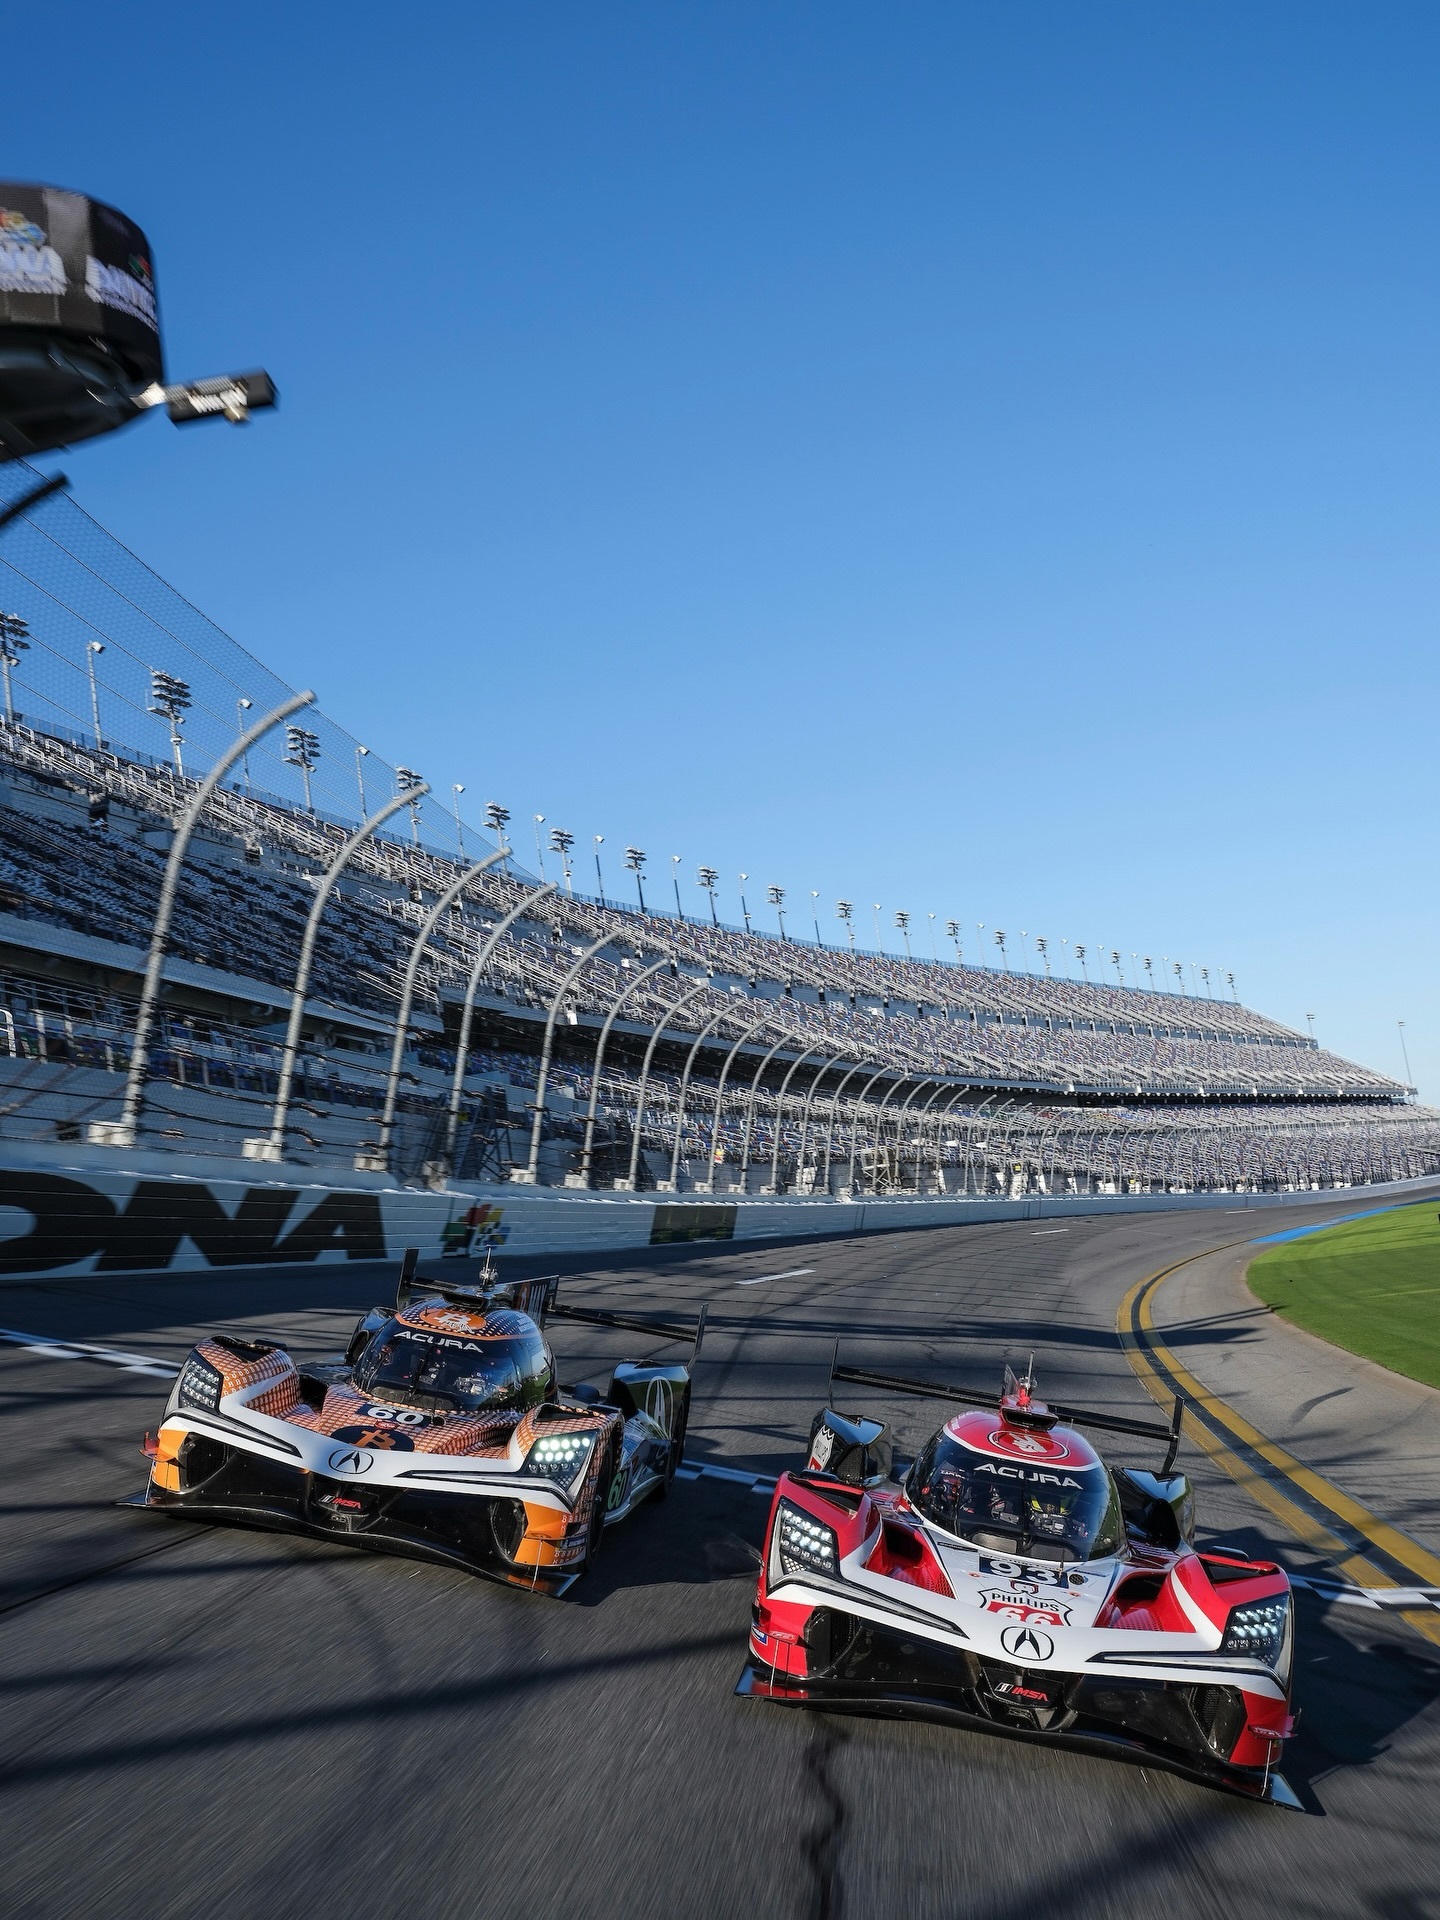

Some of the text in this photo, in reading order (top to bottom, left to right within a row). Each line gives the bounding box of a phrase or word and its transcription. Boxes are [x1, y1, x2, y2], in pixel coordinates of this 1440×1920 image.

[393, 1331, 483, 1353] ACURA
[367, 1407, 424, 1425] 60
[974, 1463, 1084, 1491] ACURA
[607, 1470, 628, 1510] 60
[990, 1560, 1059, 1585] 93
[992, 1593, 1060, 1612] PHILLIPS
[1011, 1685, 1049, 1702] IMSA
